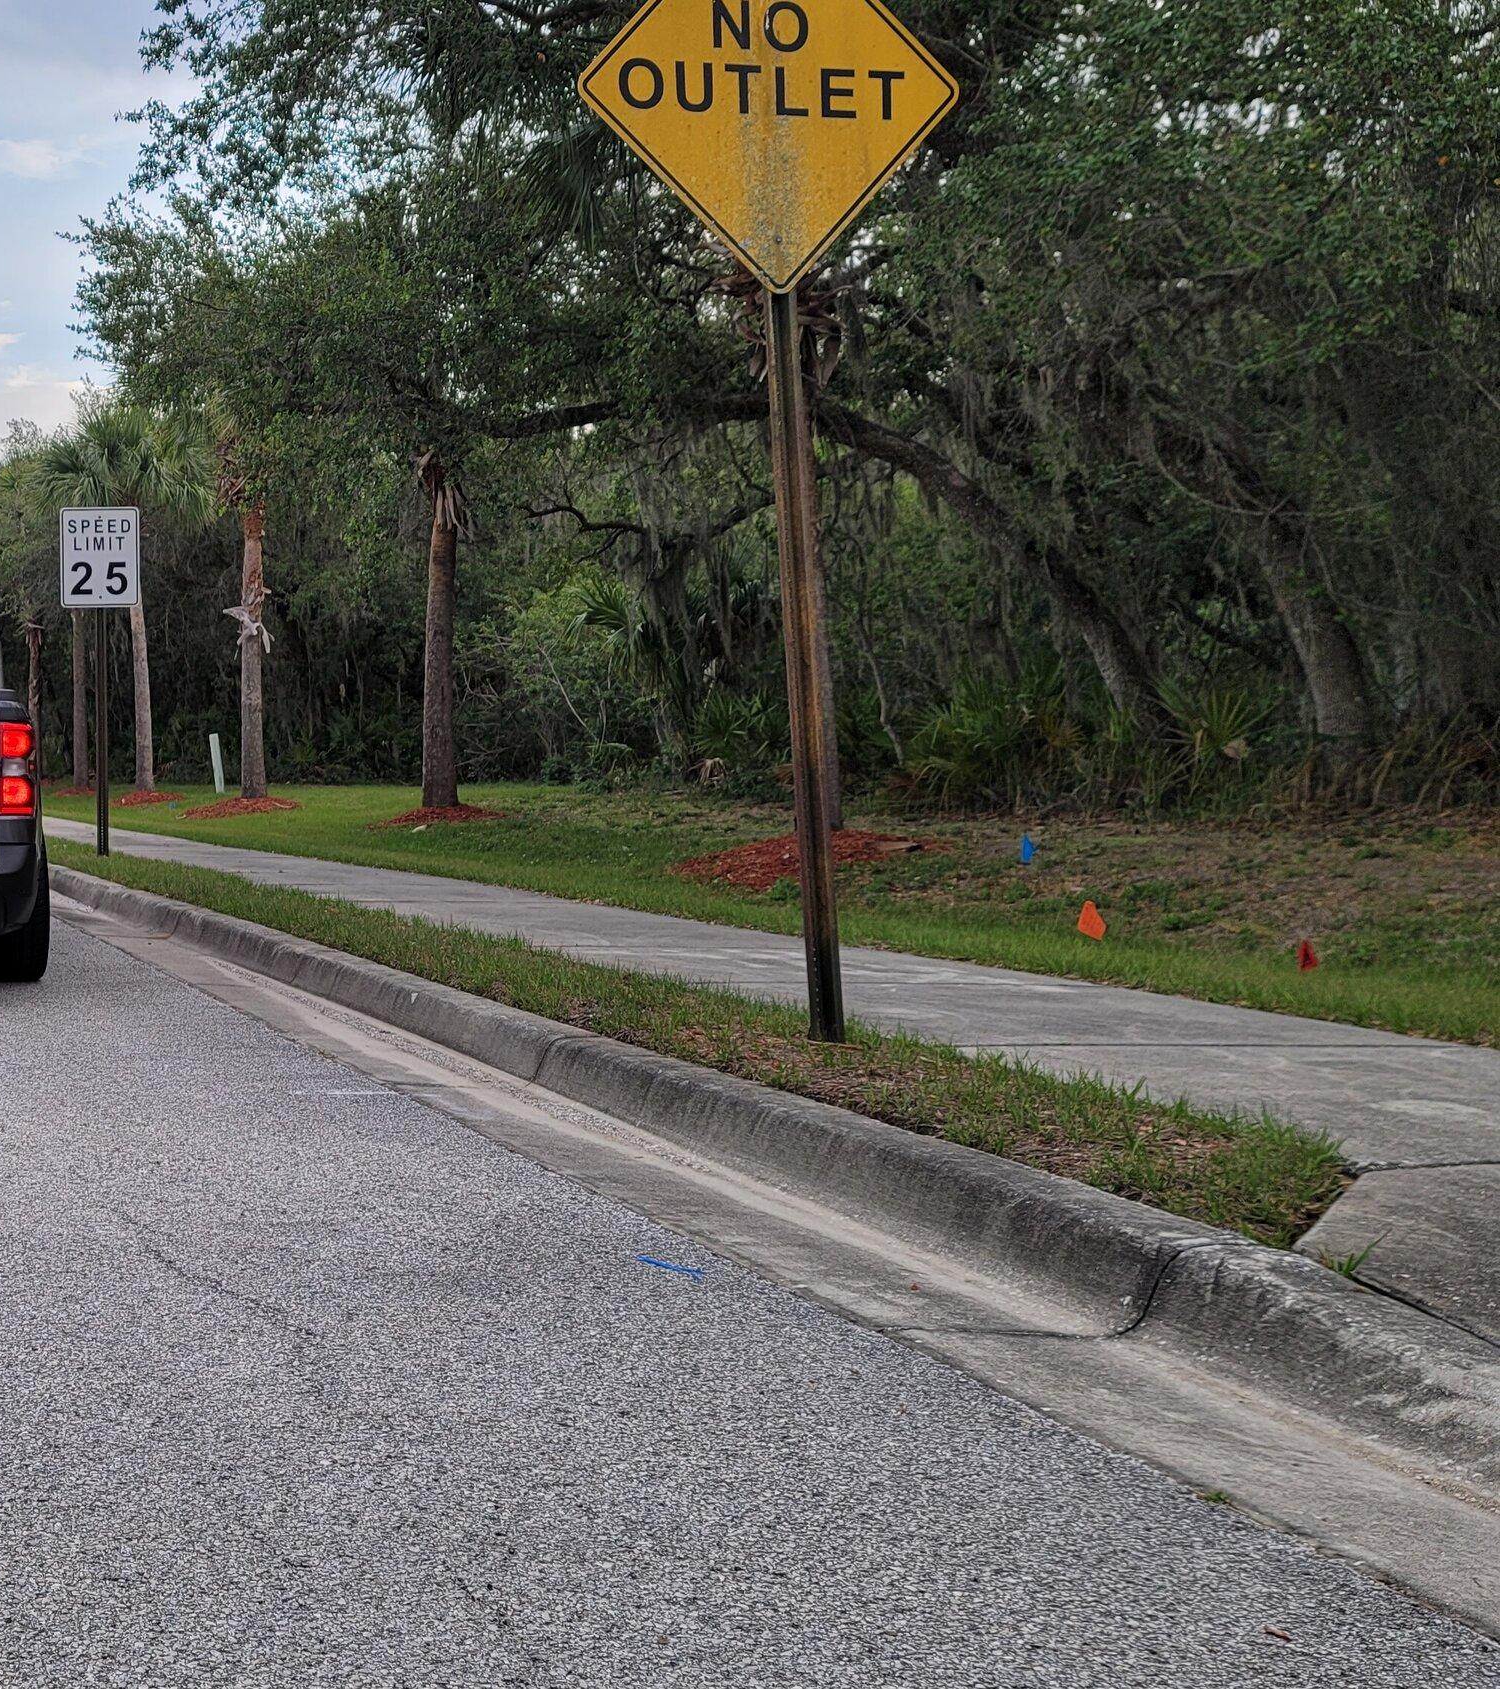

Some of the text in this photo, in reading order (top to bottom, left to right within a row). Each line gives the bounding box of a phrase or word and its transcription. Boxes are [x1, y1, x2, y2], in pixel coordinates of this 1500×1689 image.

[712, 0, 809, 53] NO
[618, 57, 905, 121] OUTLET
[67, 519, 131, 534] SPEED
[73, 536, 125, 551] LIMIT
[70, 561, 128, 595] 25
